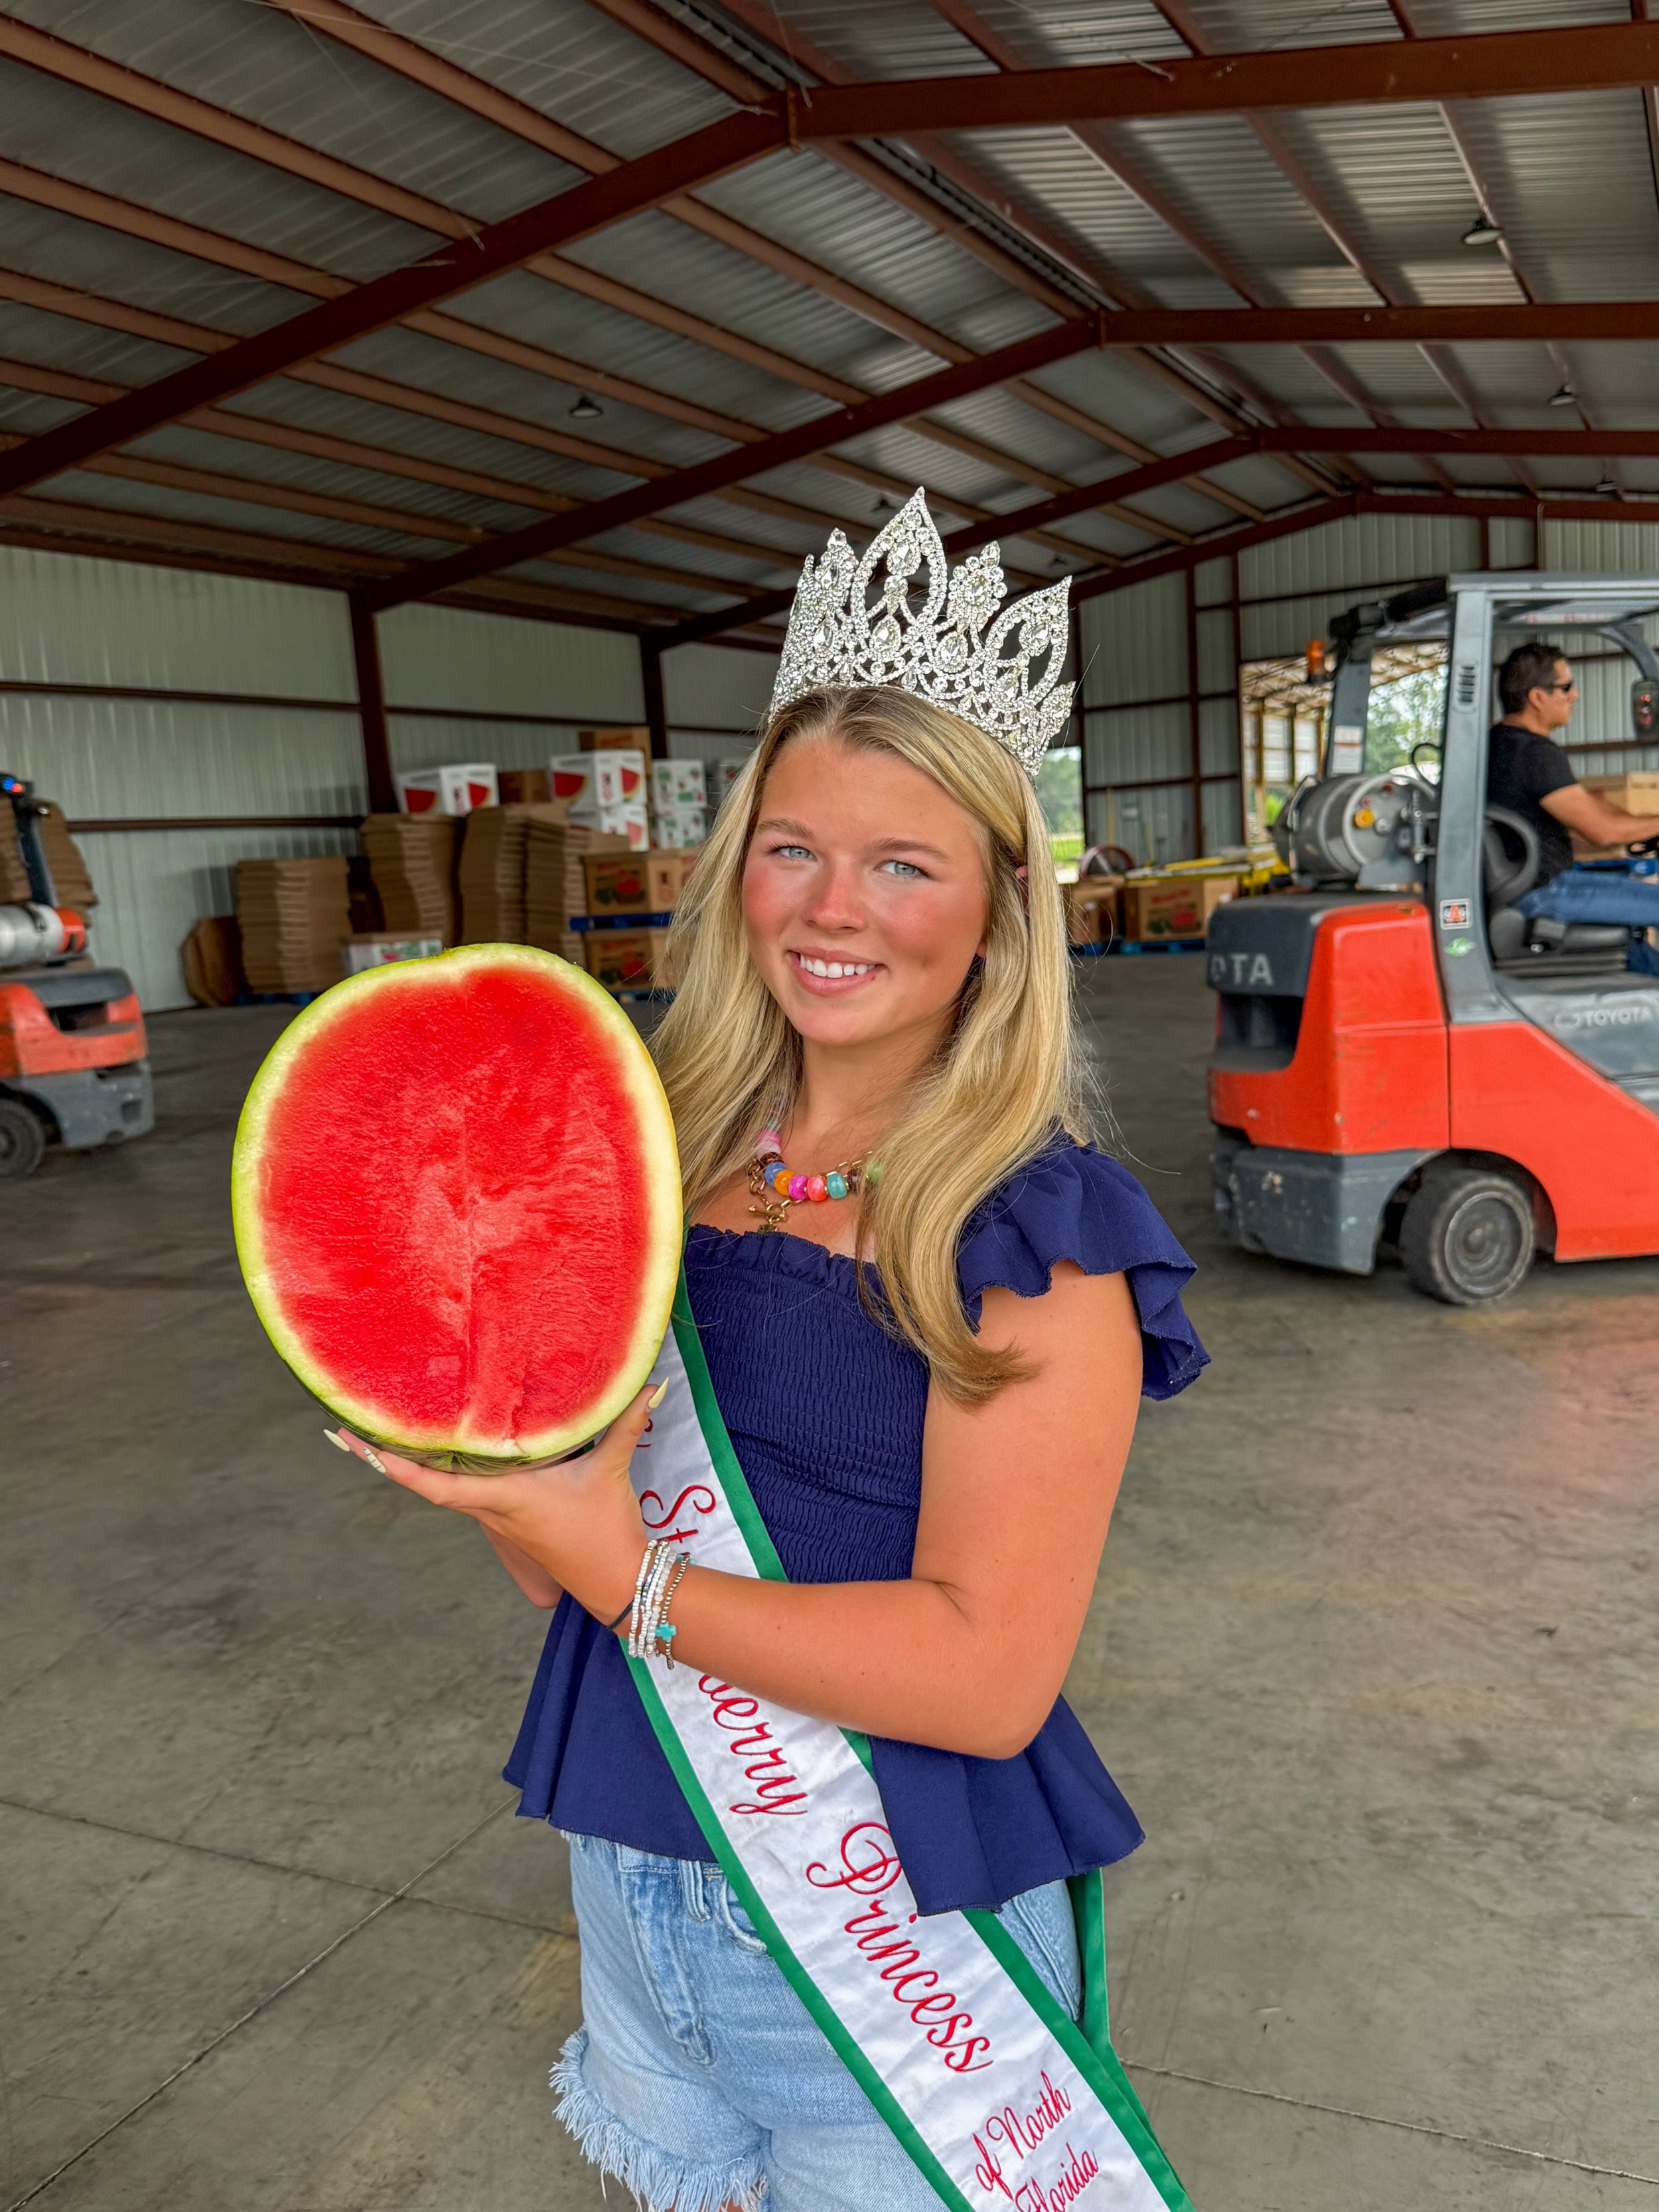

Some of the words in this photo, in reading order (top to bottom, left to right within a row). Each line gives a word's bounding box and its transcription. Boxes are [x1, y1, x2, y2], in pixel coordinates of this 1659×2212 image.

[1583, 1007, 1652, 1027] TOYOTA
[806, 1821, 994, 2073] Princess
[985, 2069, 1071, 2160] North
[975, 2132, 1014, 2202] of
